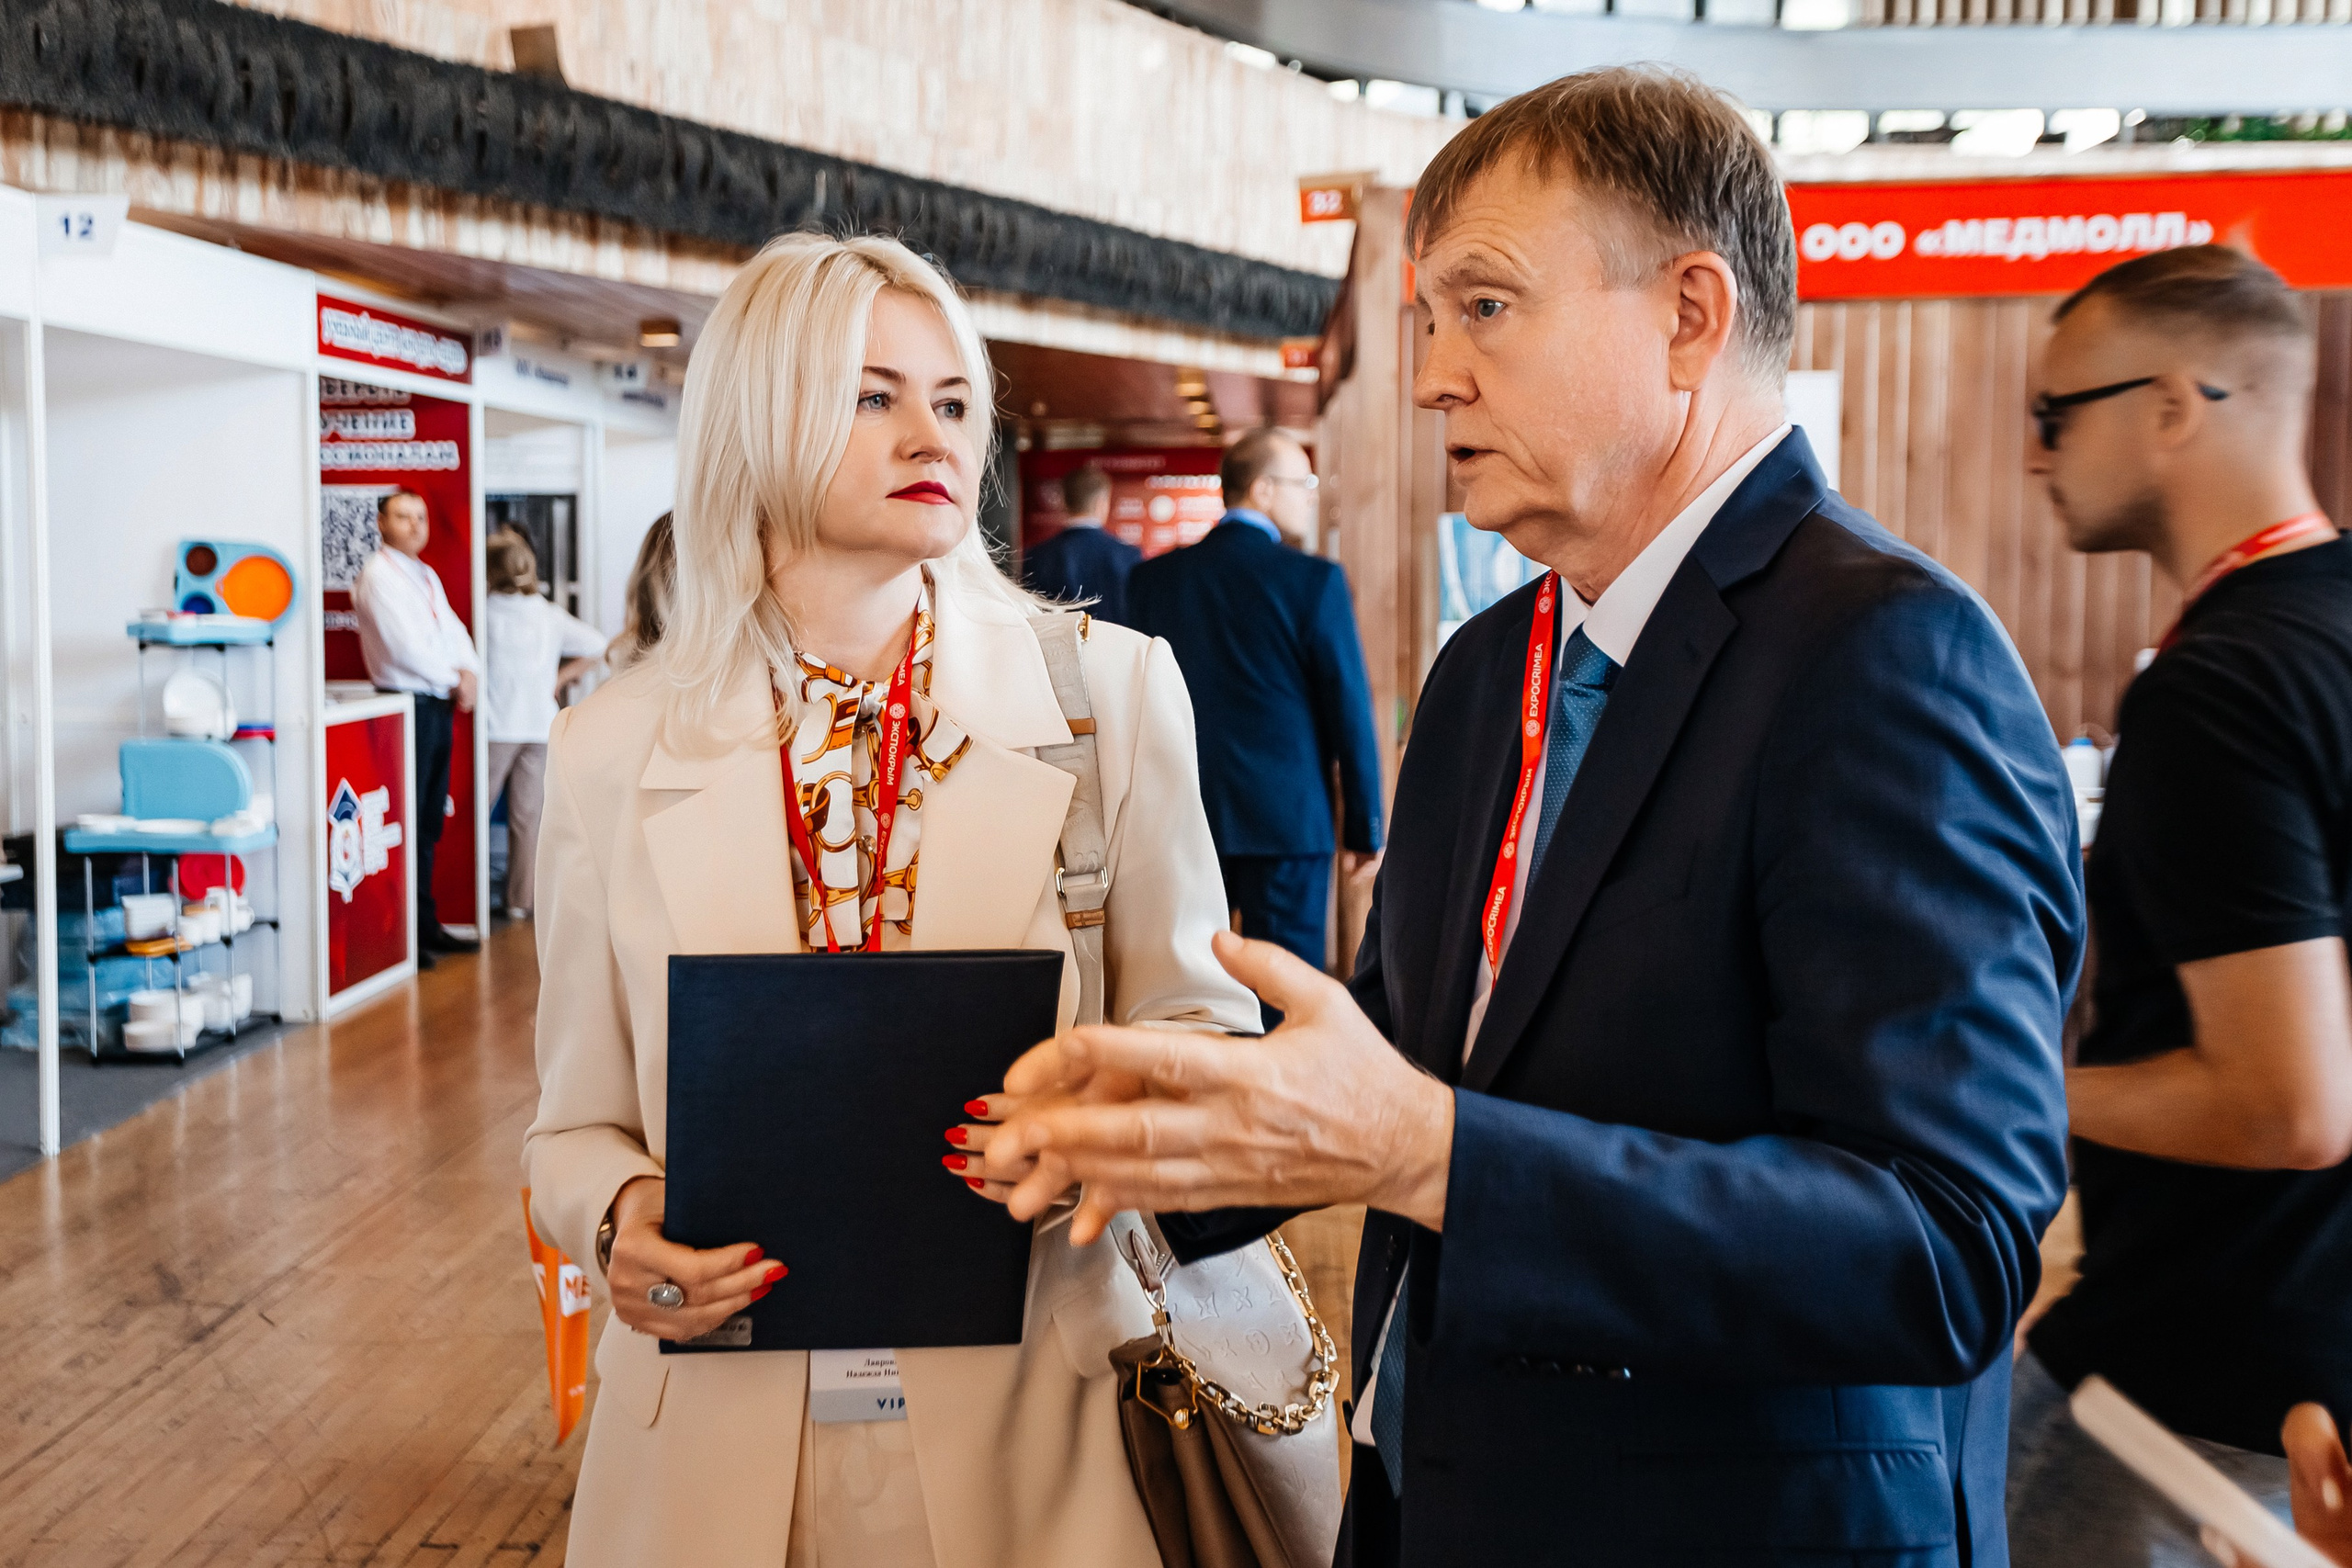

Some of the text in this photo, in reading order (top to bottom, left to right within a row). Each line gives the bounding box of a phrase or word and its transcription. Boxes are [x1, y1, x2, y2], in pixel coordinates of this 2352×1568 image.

[60, 213, 94, 239] 12
[1803, 212, 2213, 262] ООО «МЕДМОЛЛ»
[1529, 643, 1544, 717] EXPOCRIMEA
[887, 720, 900, 785] ЭКСПОКРЫМ
[876, 1397, 905, 1410] VIP
